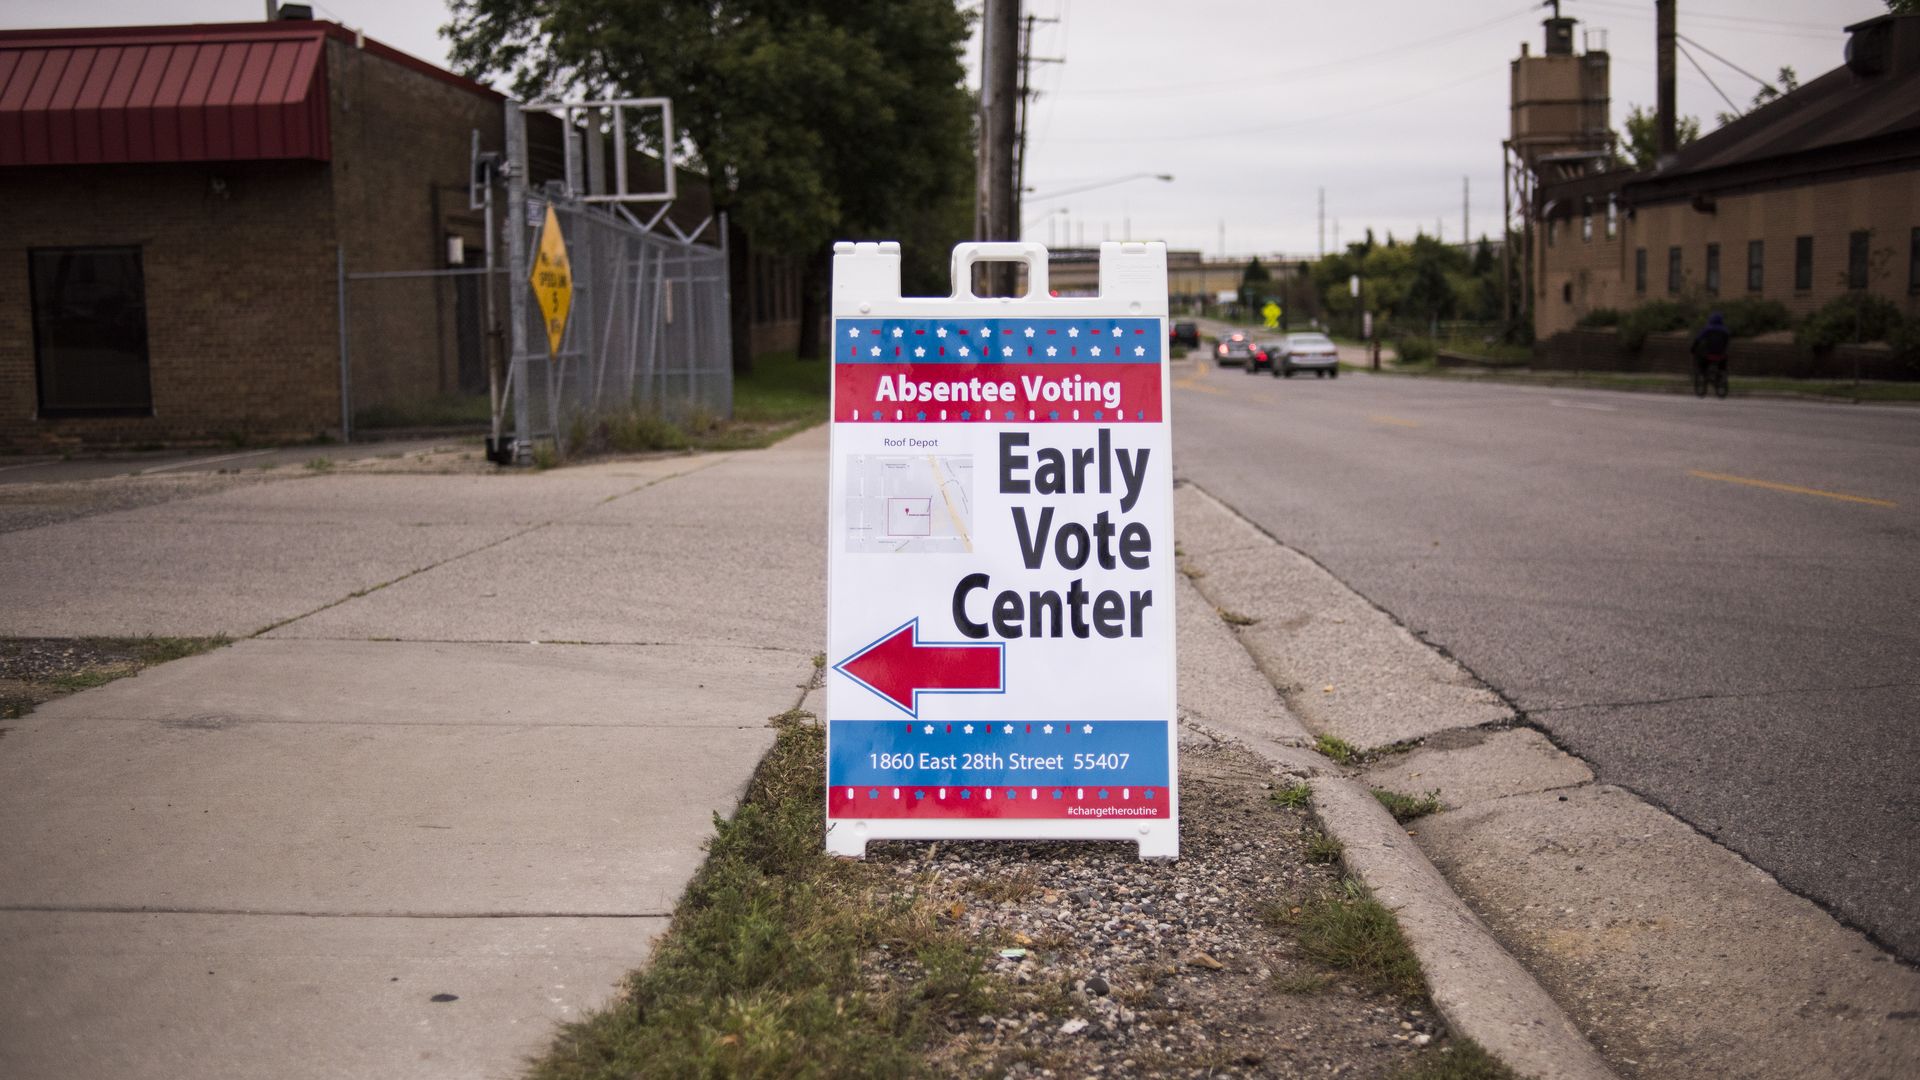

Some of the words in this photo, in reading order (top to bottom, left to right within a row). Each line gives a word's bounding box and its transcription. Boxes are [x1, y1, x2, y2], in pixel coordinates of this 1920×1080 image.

[876, 374, 1015, 401] Absentee
[1021, 374, 1121, 408] Voting
[884, 438, 906, 447] Roof
[909, 438, 938, 449] Depot
[1000, 428, 1151, 514] Early
[1011, 506, 1152, 571] Vote
[952, 572, 1153, 639] Center
[870, 753, 914, 770] 1860
[919, 753, 957, 770] East
[962, 753, 1004, 770] 28th
[1009, 753, 1064, 770] Street
[1073, 753, 1130, 770] 55407
[1067, 805, 1158, 818] #changetheroutine
